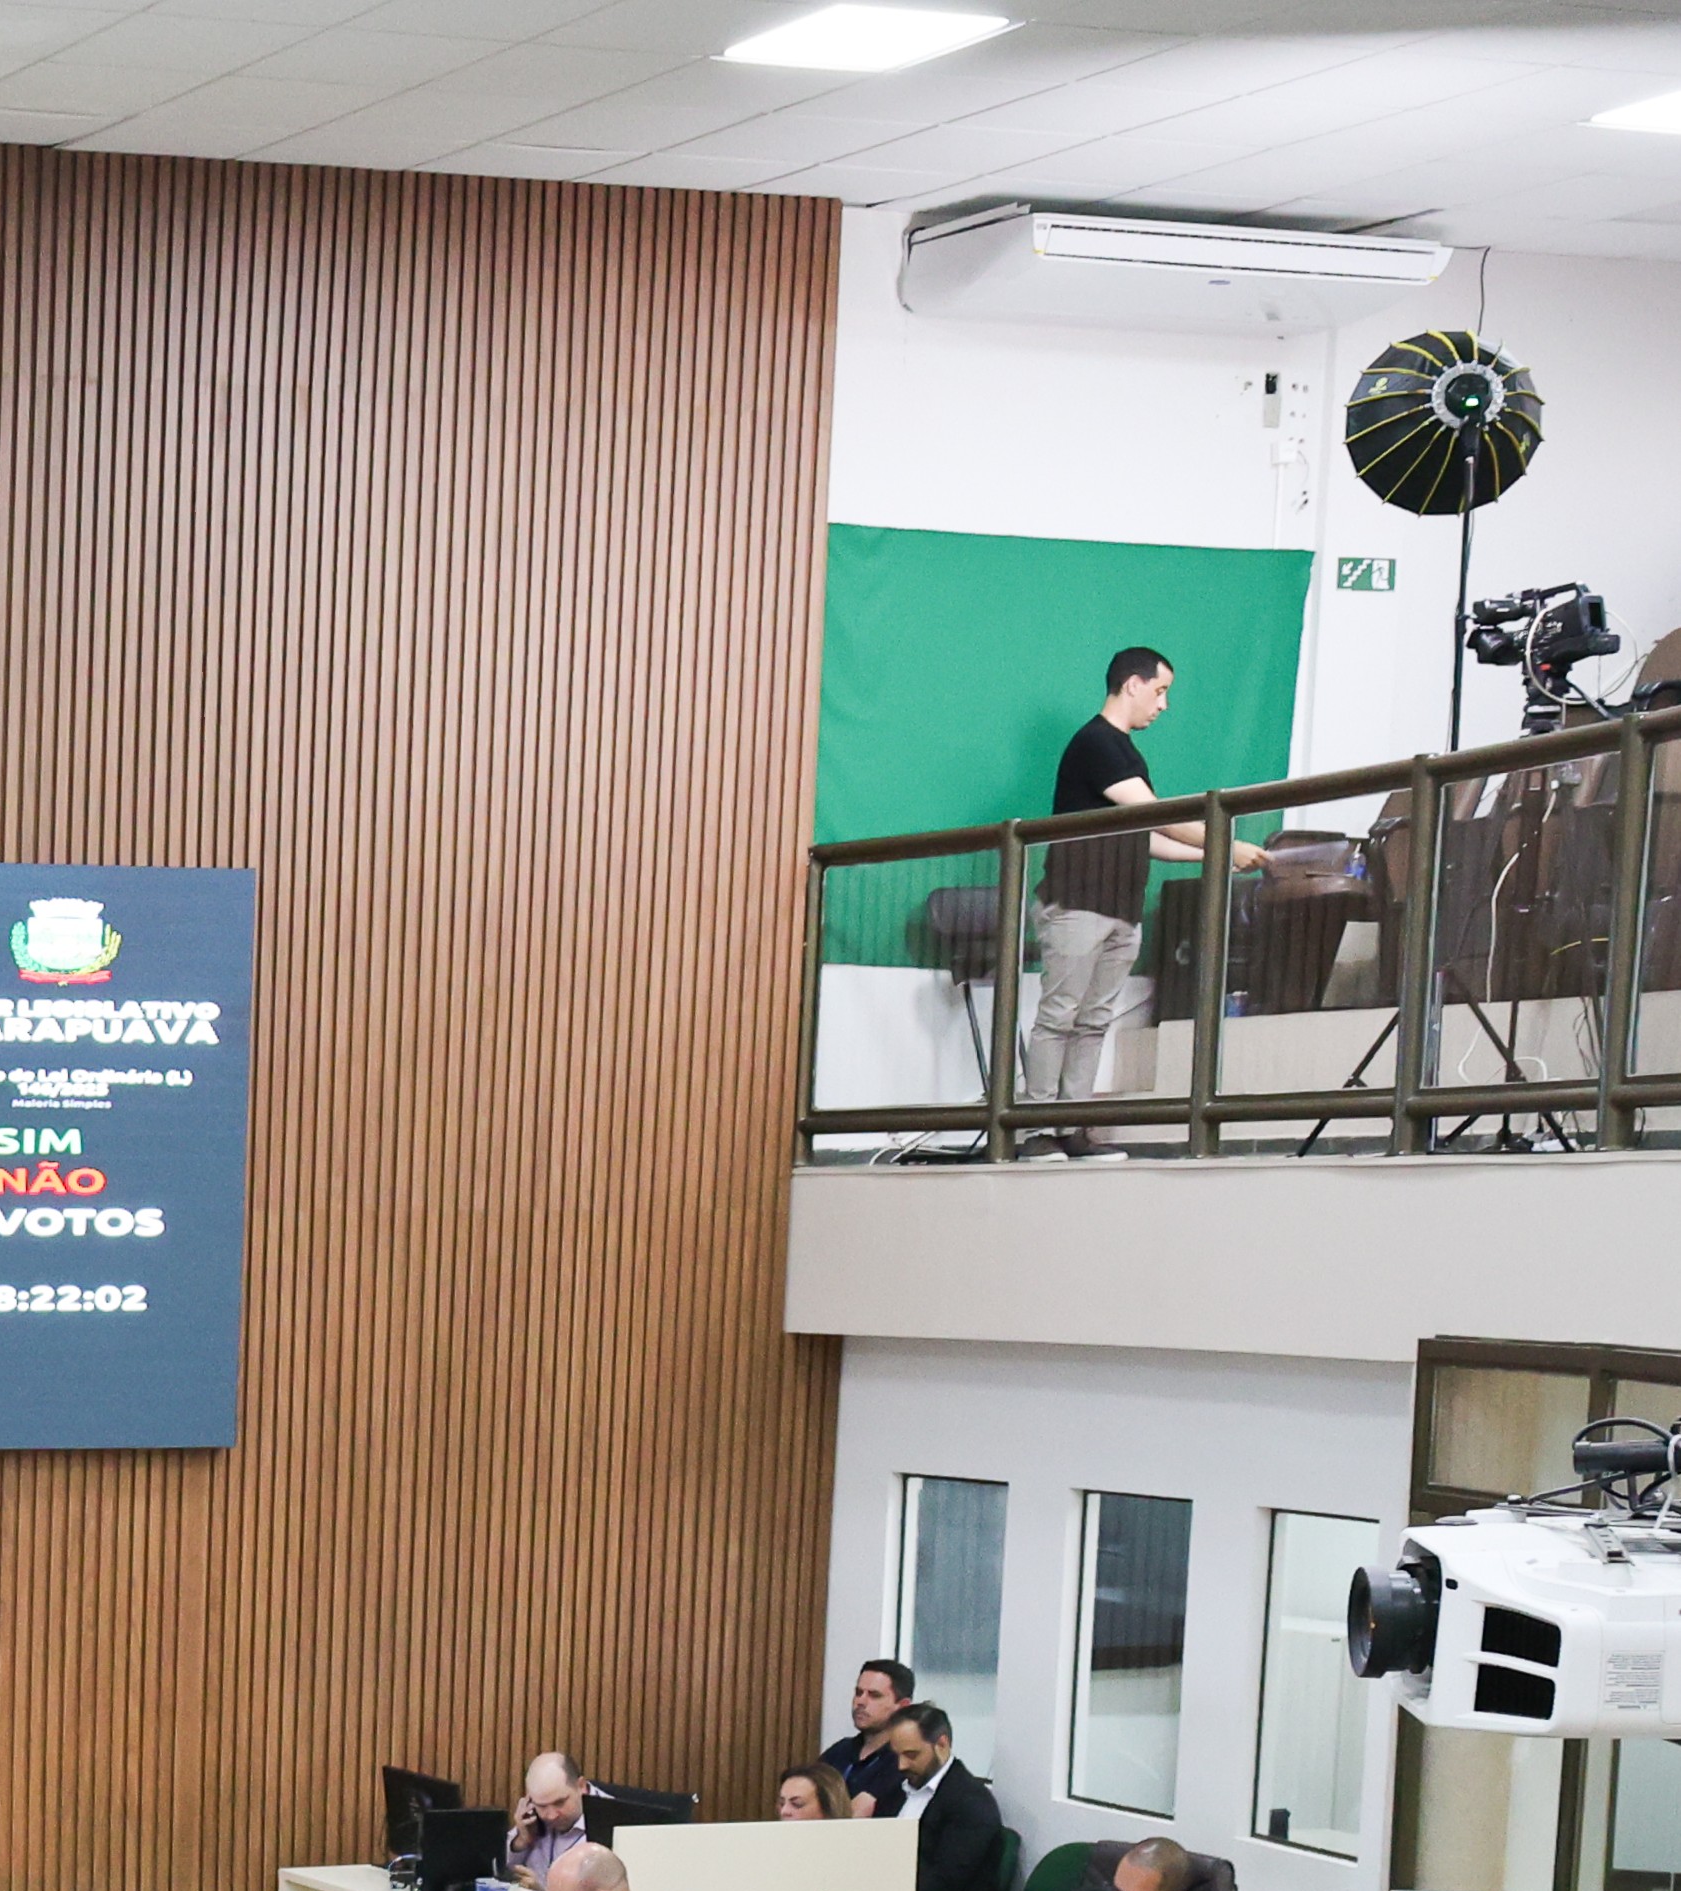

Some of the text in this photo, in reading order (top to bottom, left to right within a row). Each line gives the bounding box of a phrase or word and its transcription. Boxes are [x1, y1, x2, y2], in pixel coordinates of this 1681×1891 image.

[16, 999, 222, 1021] LEGISLATIVO
[8, 1068, 36, 1083] de
[37, 1068, 69, 1083] Lei
[11, 1099, 113, 1110] Maioria Simples
